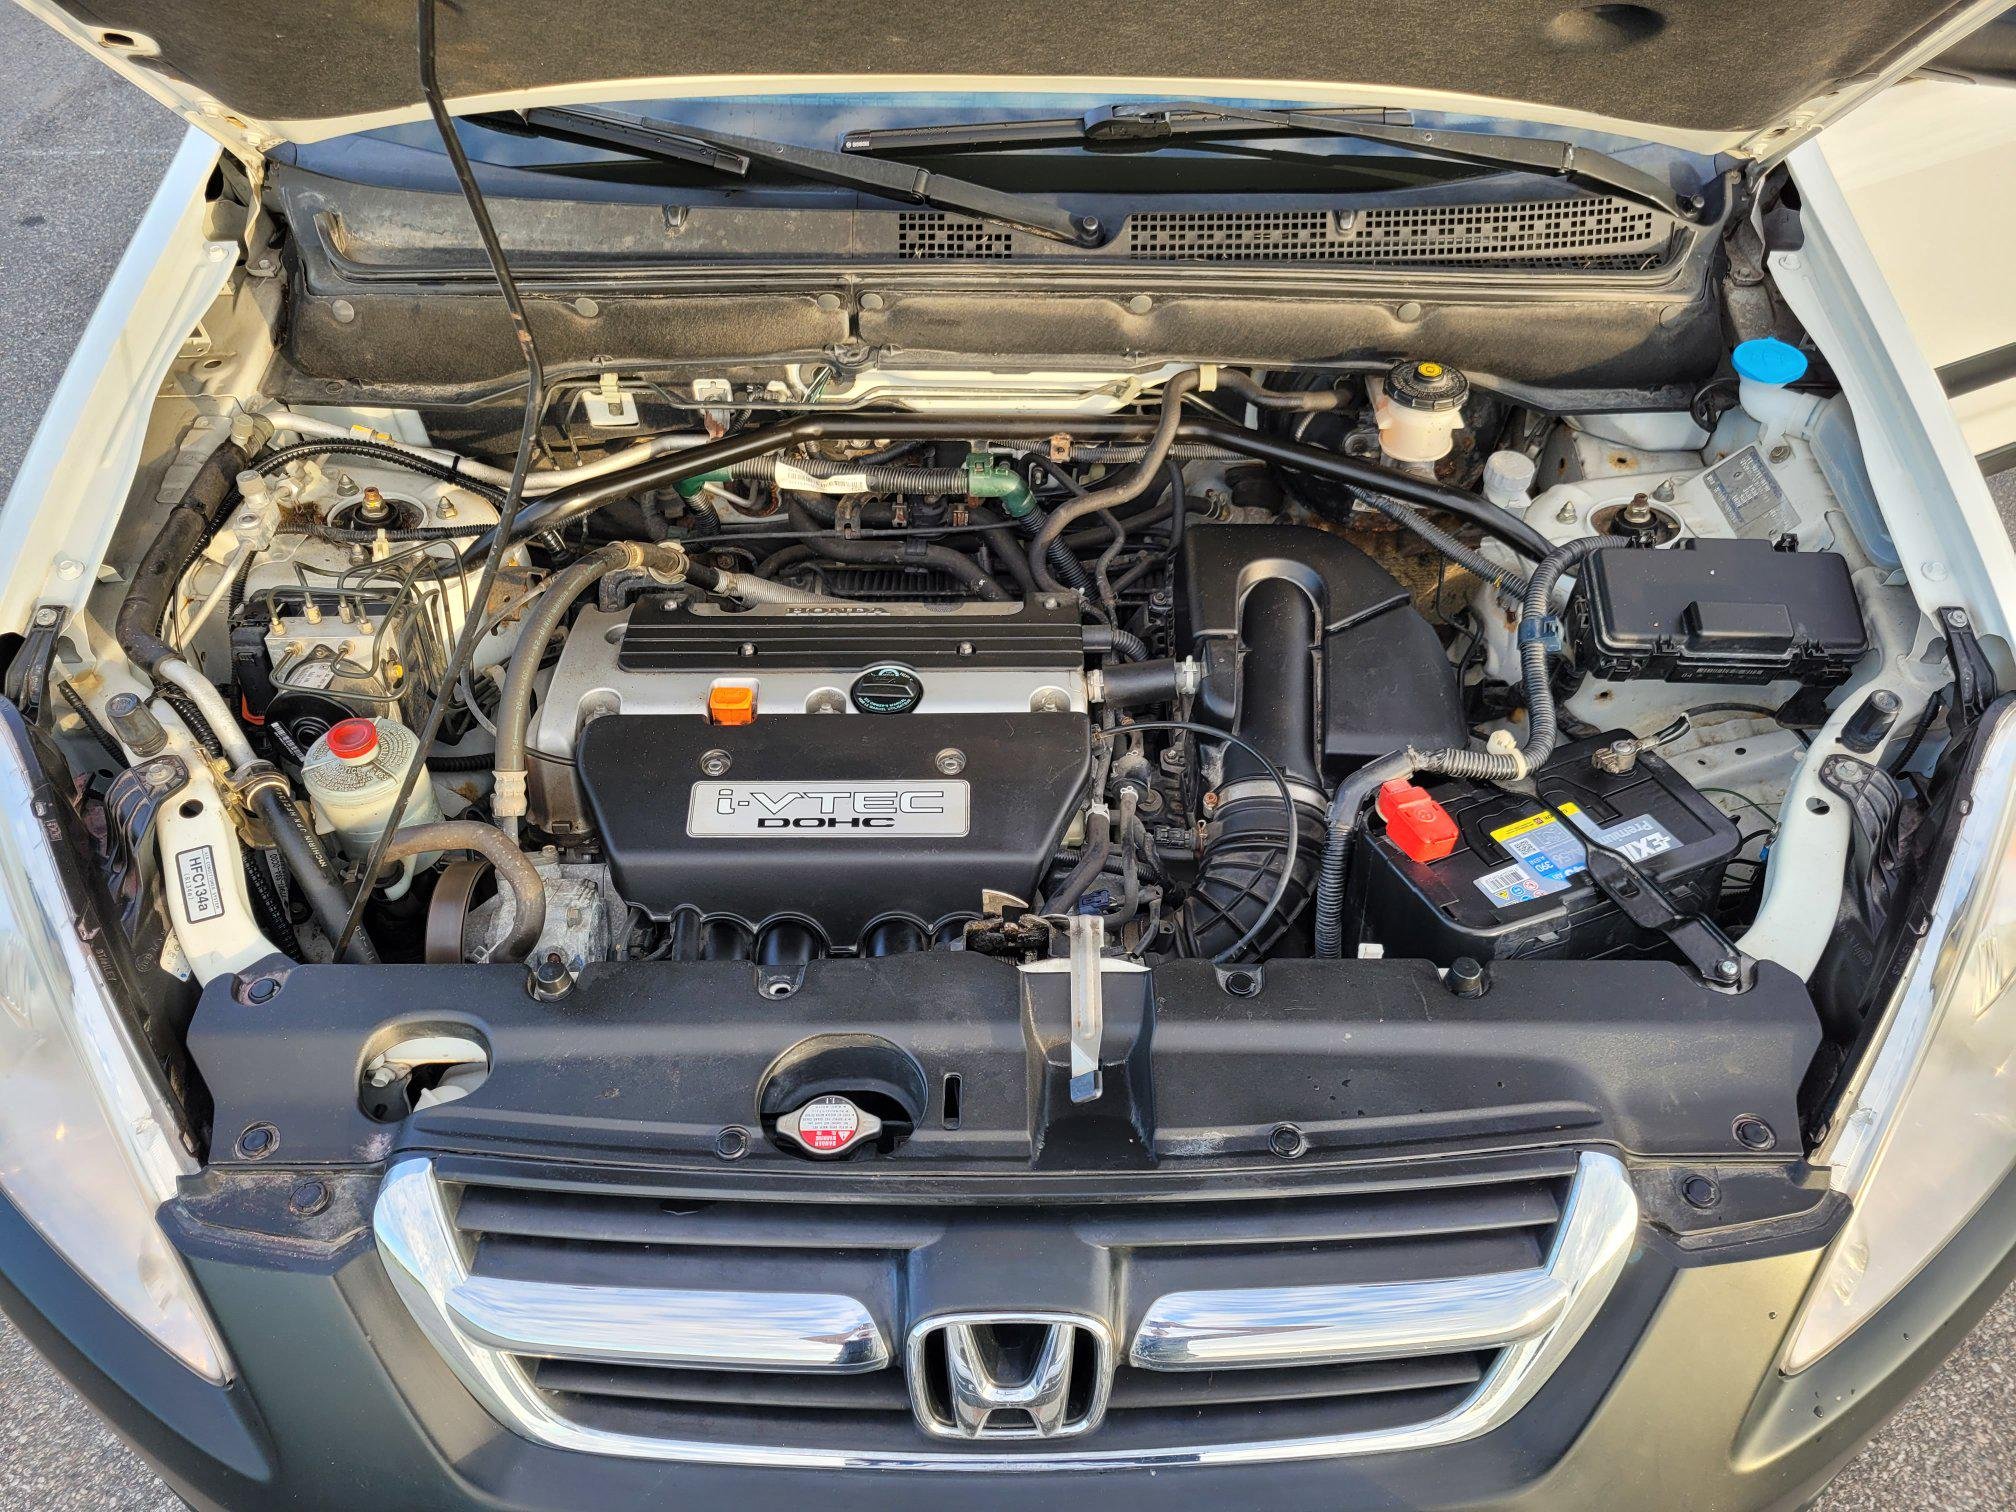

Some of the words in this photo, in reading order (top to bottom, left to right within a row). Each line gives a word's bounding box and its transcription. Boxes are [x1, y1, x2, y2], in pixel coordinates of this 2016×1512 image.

[785, 607, 891, 617] HONDA
[716, 788, 945, 815] i-VTEC
[757, 817, 896, 828] DOHC
[1615, 831, 1672, 863] EXI
[188, 856, 209, 912] HFC134a
